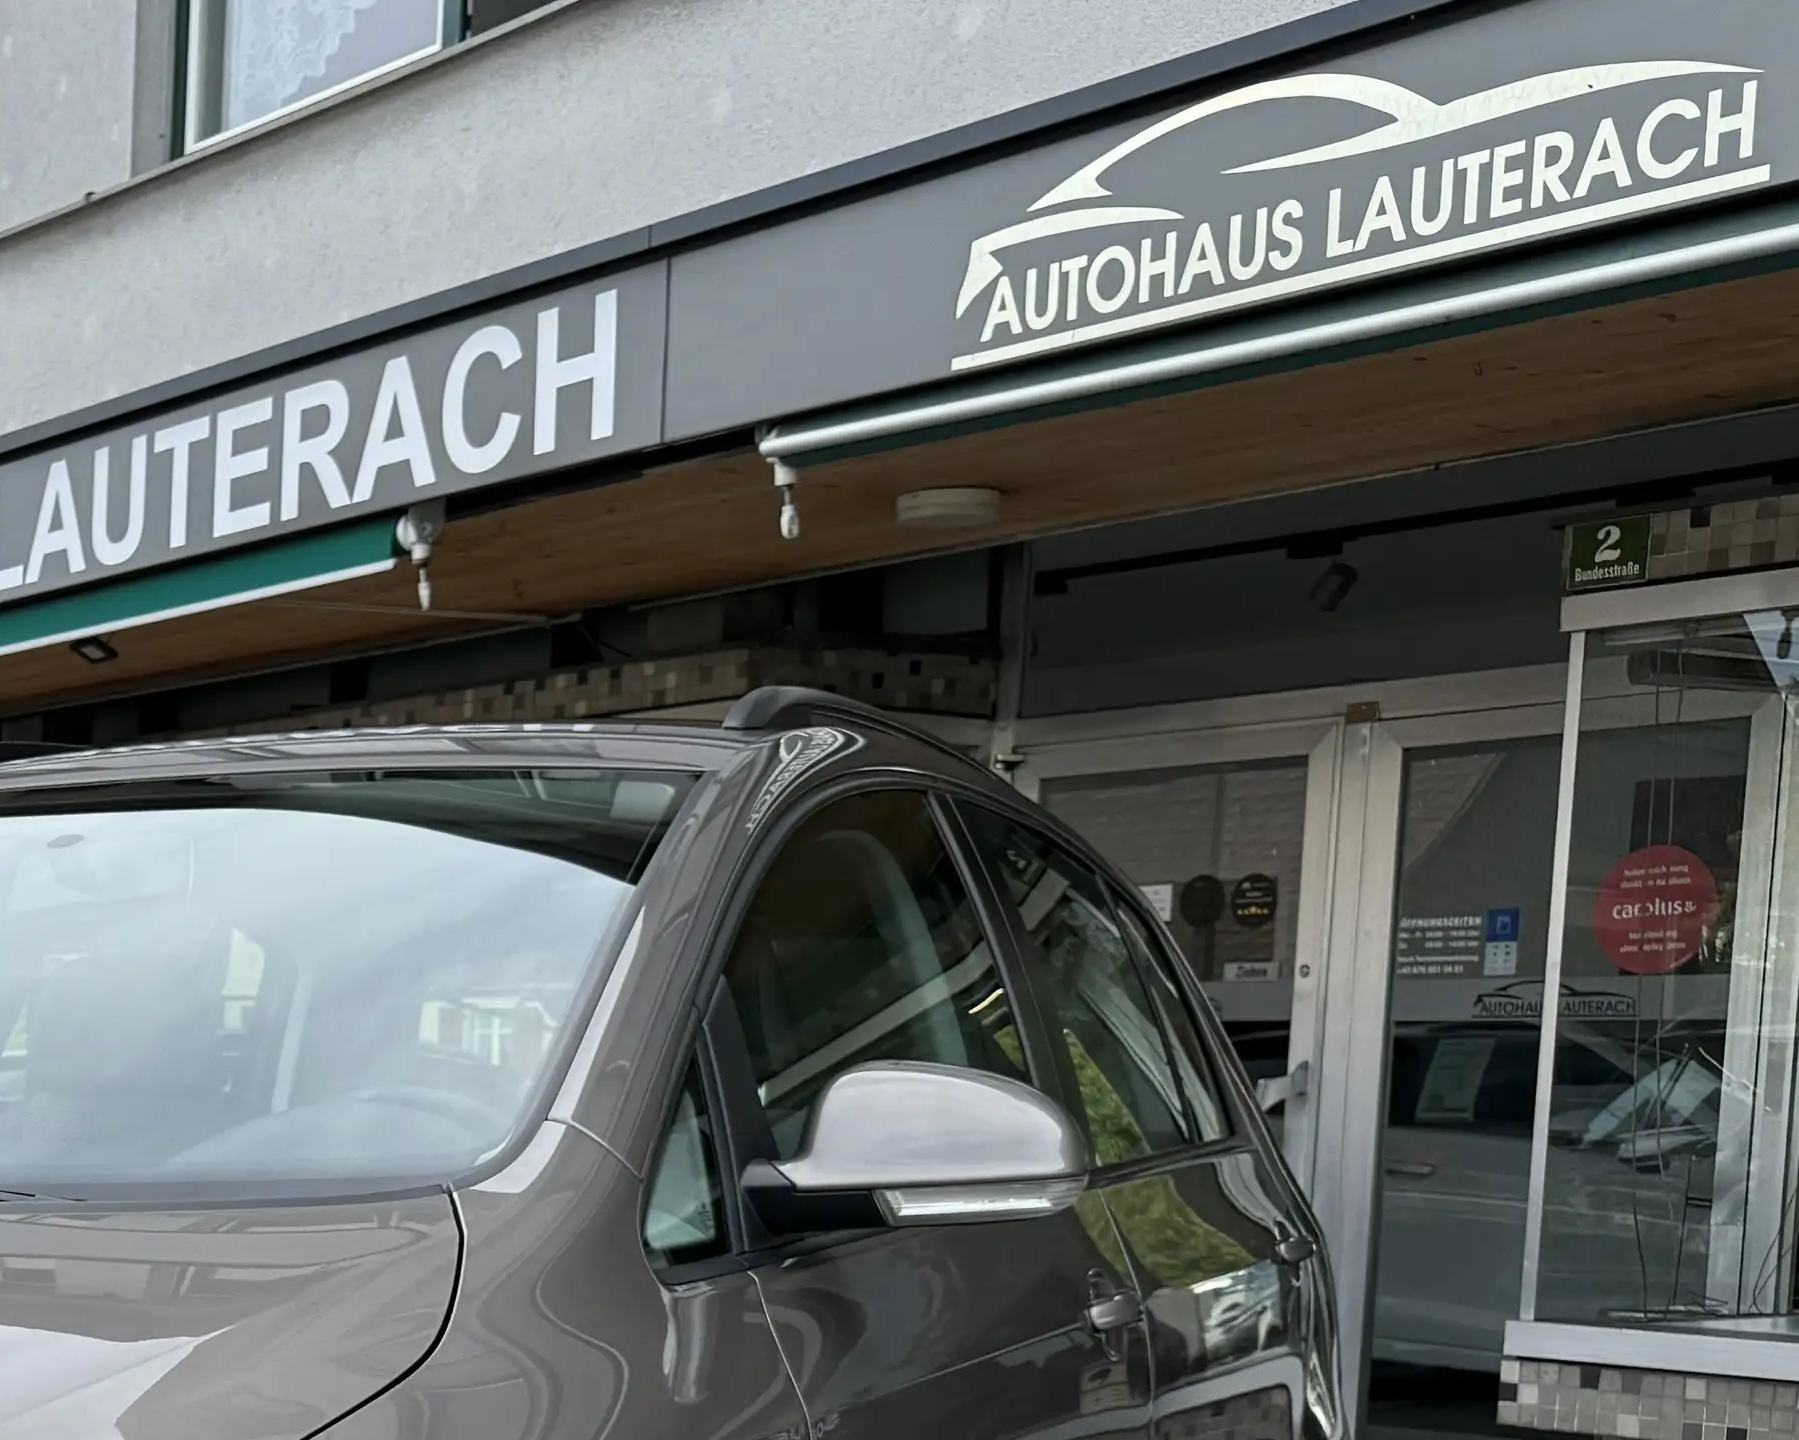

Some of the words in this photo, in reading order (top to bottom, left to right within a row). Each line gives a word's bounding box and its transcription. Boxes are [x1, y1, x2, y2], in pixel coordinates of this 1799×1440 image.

[979, 198, 1304, 343] AUTOHAUS
[1325, 79, 1760, 256] LAUTERACH
[1594, 525, 1621, 563] 2
[1574, 561, 1640, 582] Bundesstraße
[1479, 1000, 1543, 1015] AUTOHAU
[1562, 1000, 1637, 1015] AUTERACH
